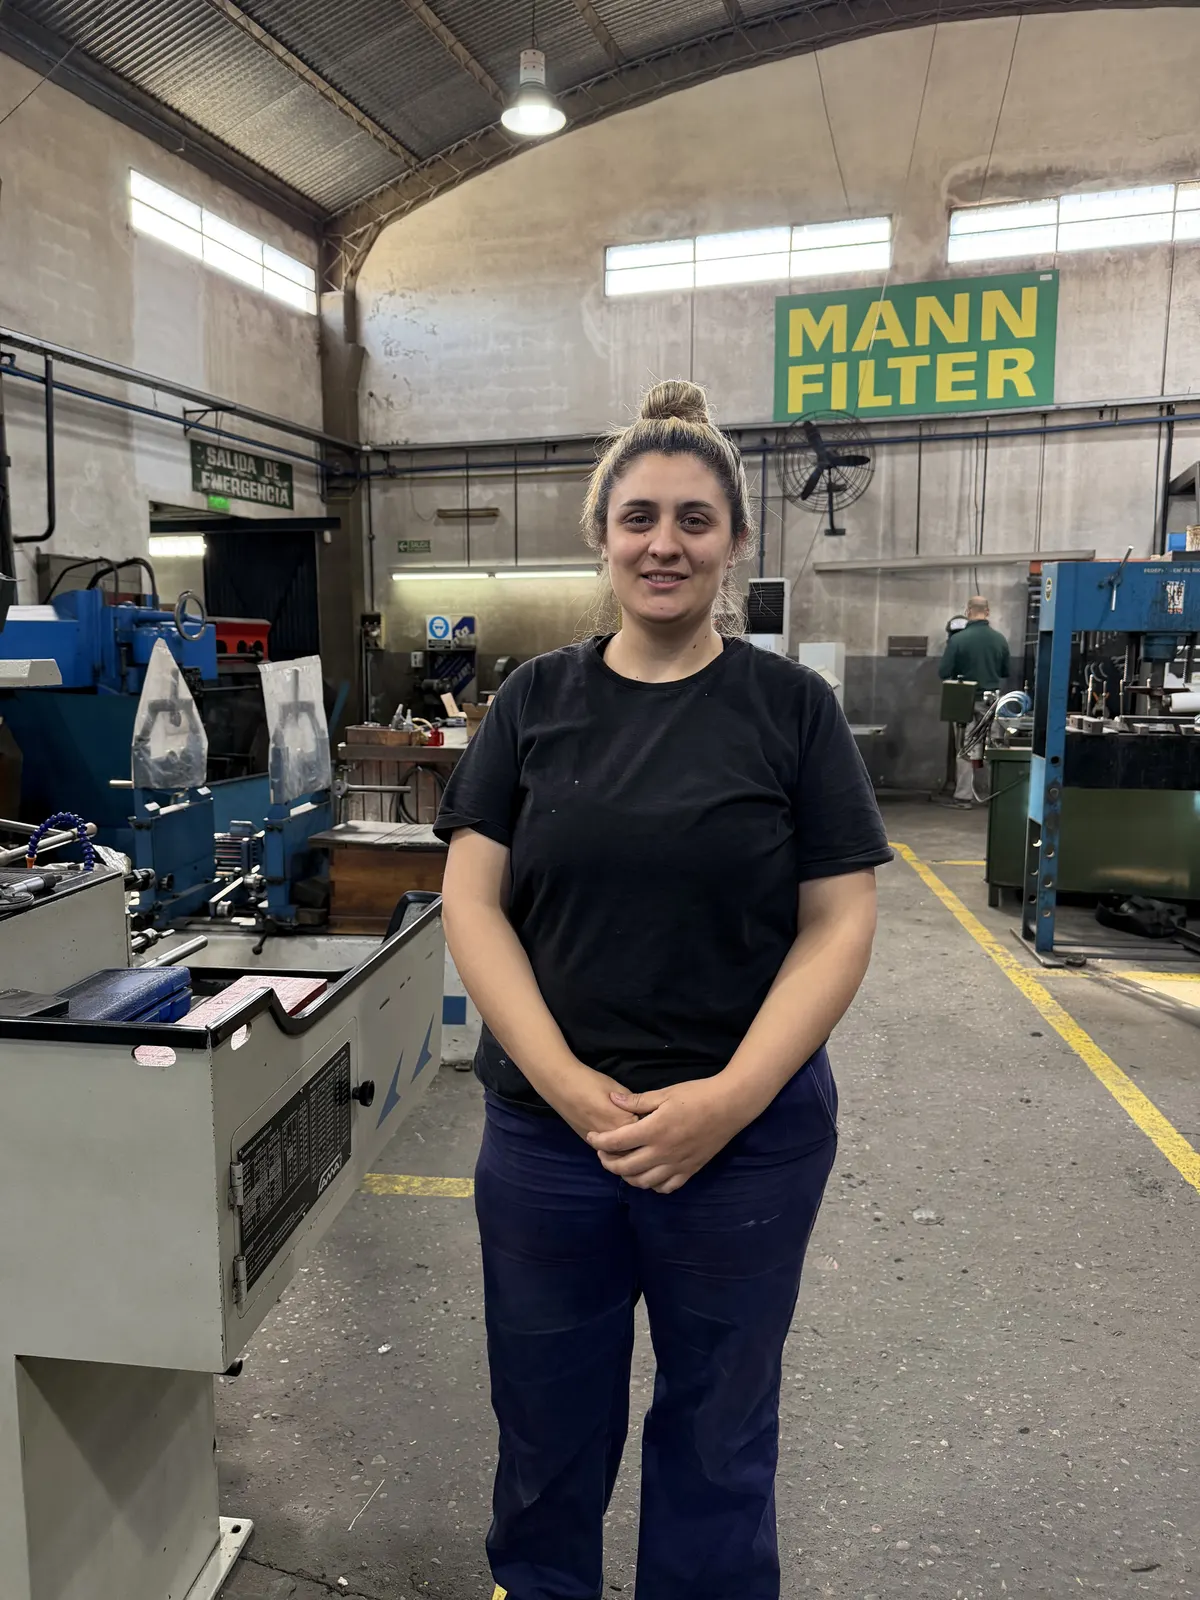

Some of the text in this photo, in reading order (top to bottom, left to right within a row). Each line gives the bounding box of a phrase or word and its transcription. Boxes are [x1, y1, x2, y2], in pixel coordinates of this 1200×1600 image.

[789, 287, 1038, 357] MANN
[787, 347, 1036, 414] FILTER
[201, 471, 290, 506] EMERGENCIA
[206, 446, 280, 480] SALIDA DE
